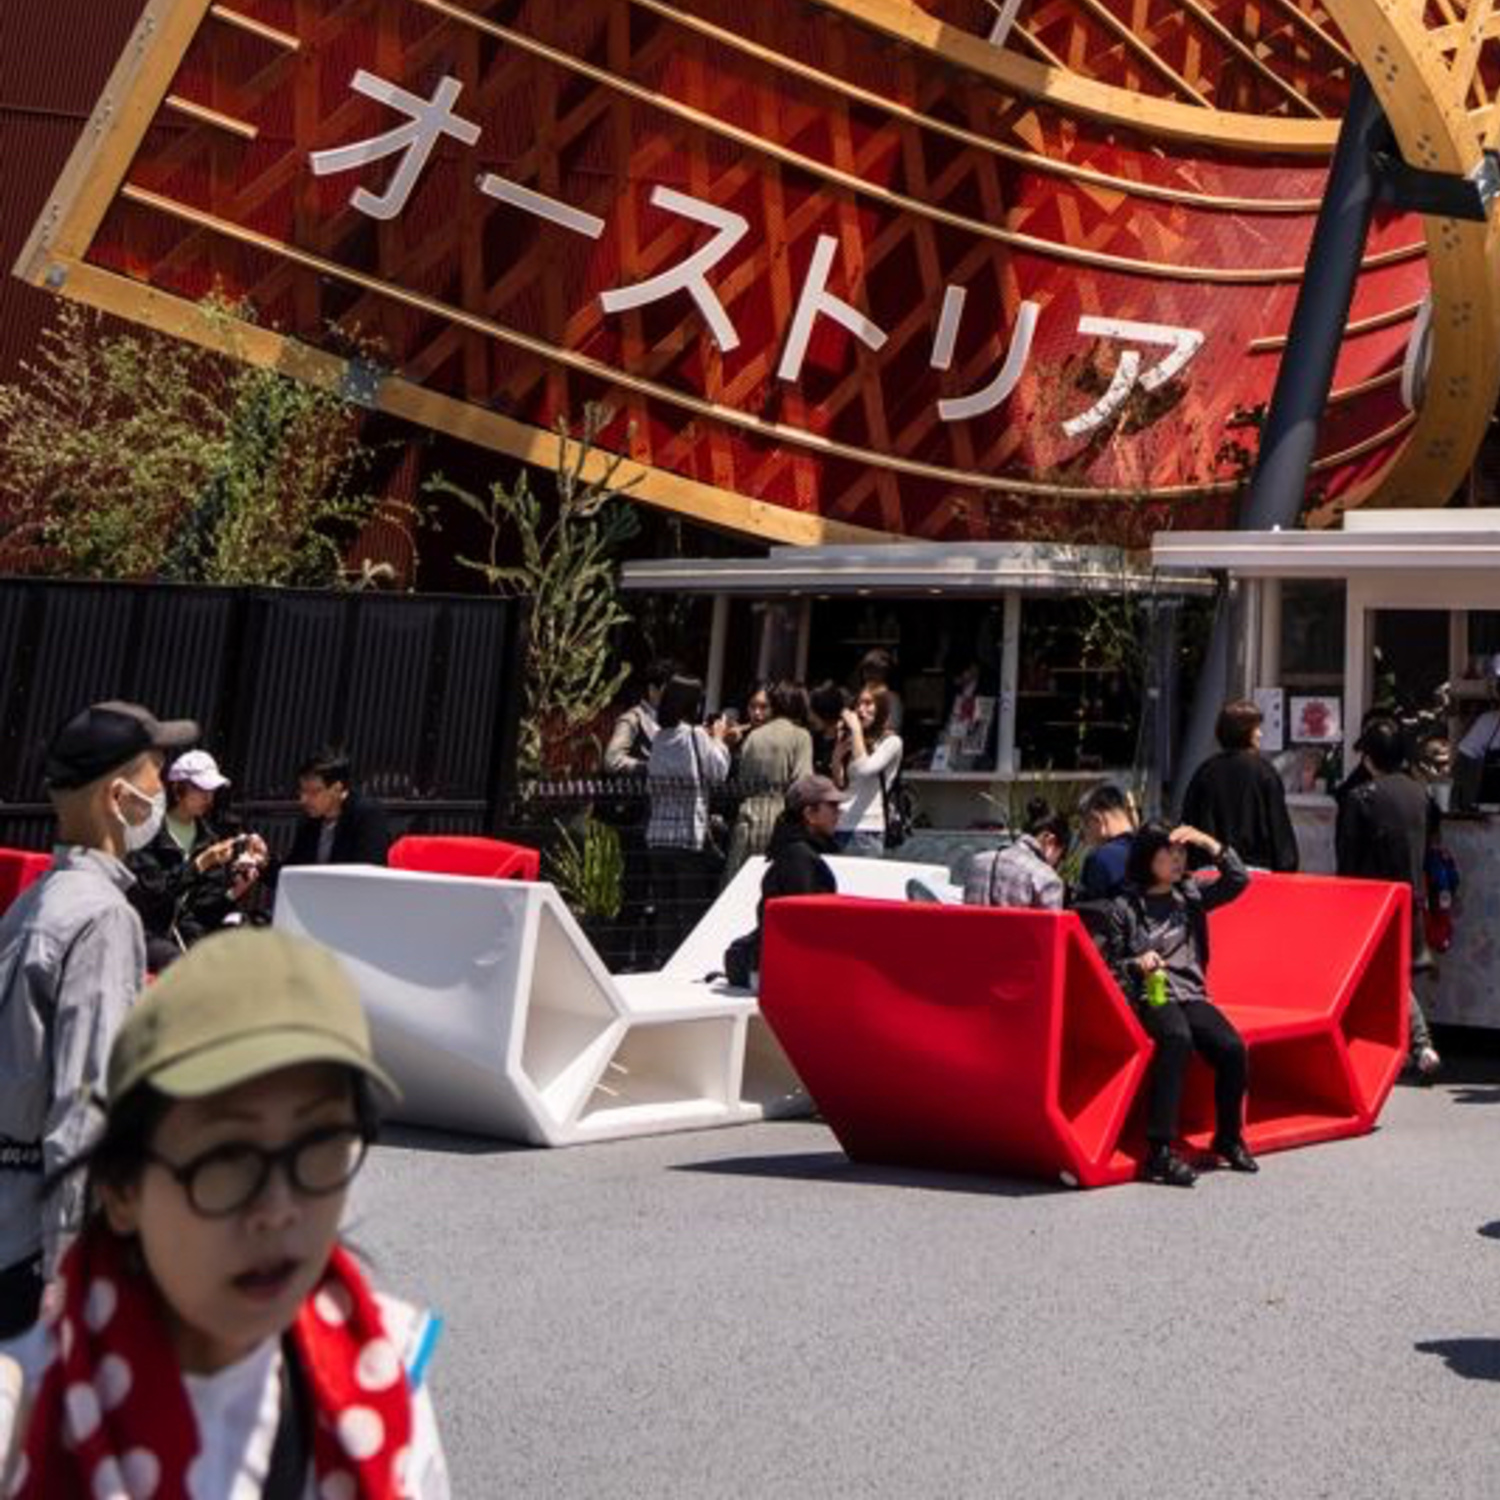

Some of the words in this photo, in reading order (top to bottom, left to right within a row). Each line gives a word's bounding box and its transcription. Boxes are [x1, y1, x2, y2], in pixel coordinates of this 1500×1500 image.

[309, 68, 1204, 437] オーストリア
